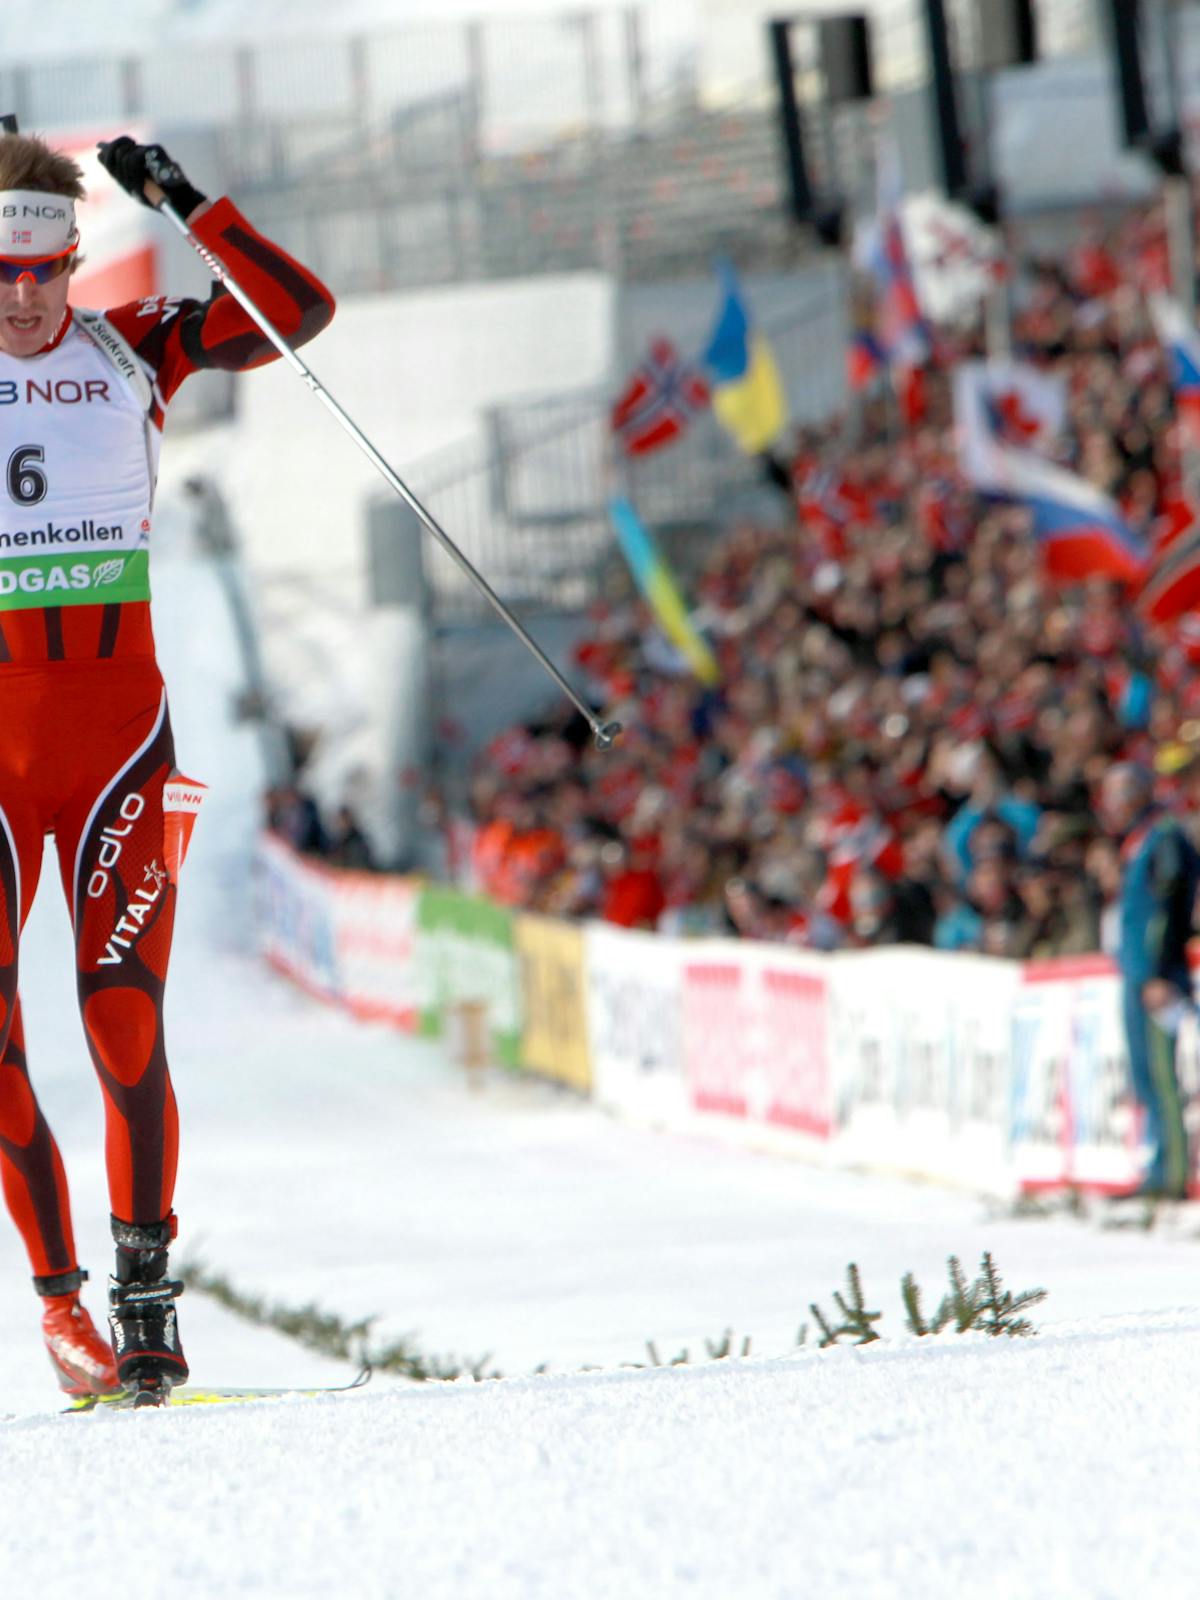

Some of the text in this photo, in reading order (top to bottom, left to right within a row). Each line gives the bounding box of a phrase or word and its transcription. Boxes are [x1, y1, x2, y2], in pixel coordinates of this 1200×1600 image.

[22, 205, 67, 221] NOR
[90, 323, 136, 379] Statkraft
[26, 379, 111, 404] NOR
[6, 444, 48, 506] 6
[96, 886, 160, 966] VITAL
